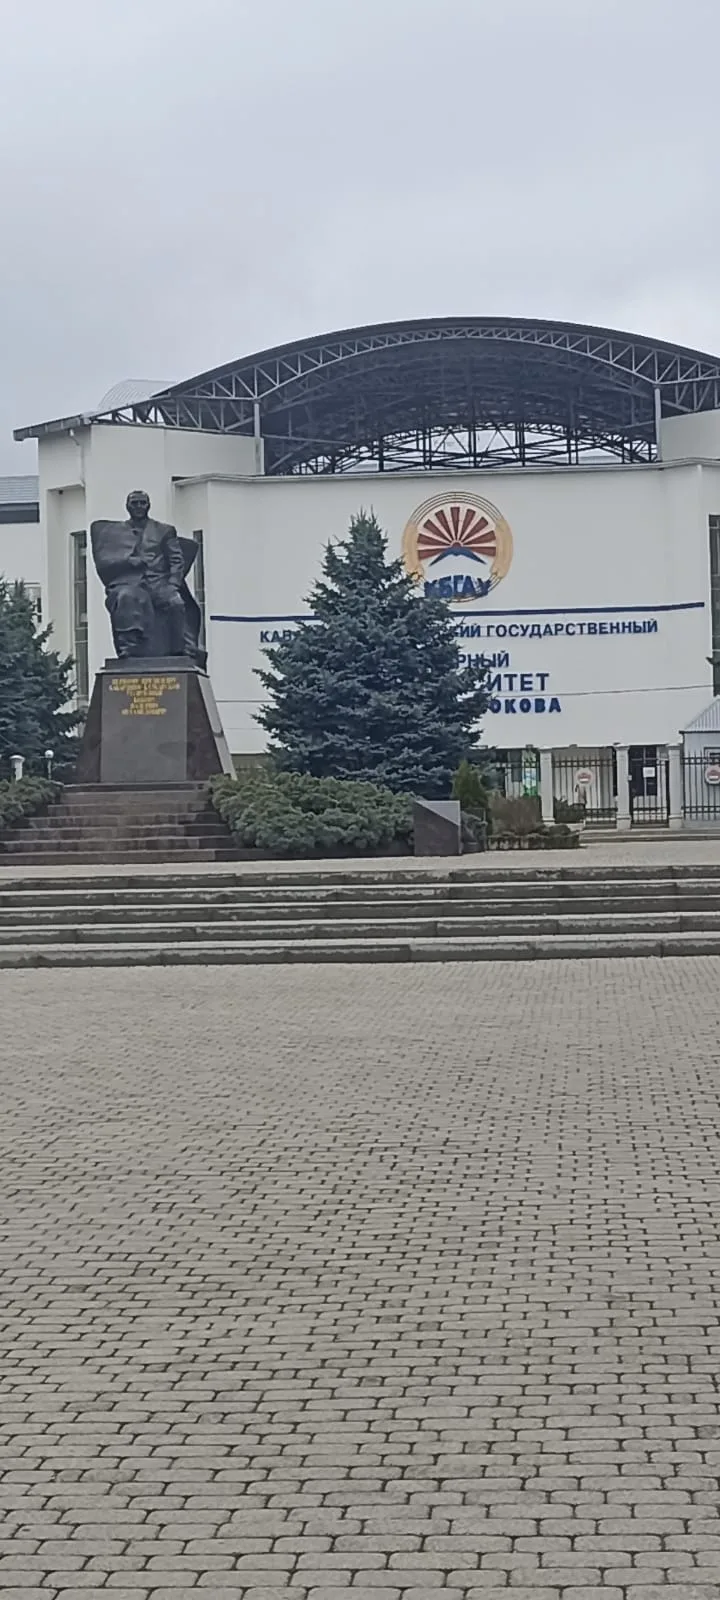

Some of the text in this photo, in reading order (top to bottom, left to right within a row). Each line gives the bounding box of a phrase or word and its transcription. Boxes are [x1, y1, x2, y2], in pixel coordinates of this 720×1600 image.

[424, 574, 491, 598] КБГАУ
[486, 618, 658, 638] ГОСУДАРСТВЕННЫЙ
[458, 650, 509, 668] РНЫЙ
[487, 672, 550, 692] ИТЕТ
[489, 697, 562, 714] ОКОВА
